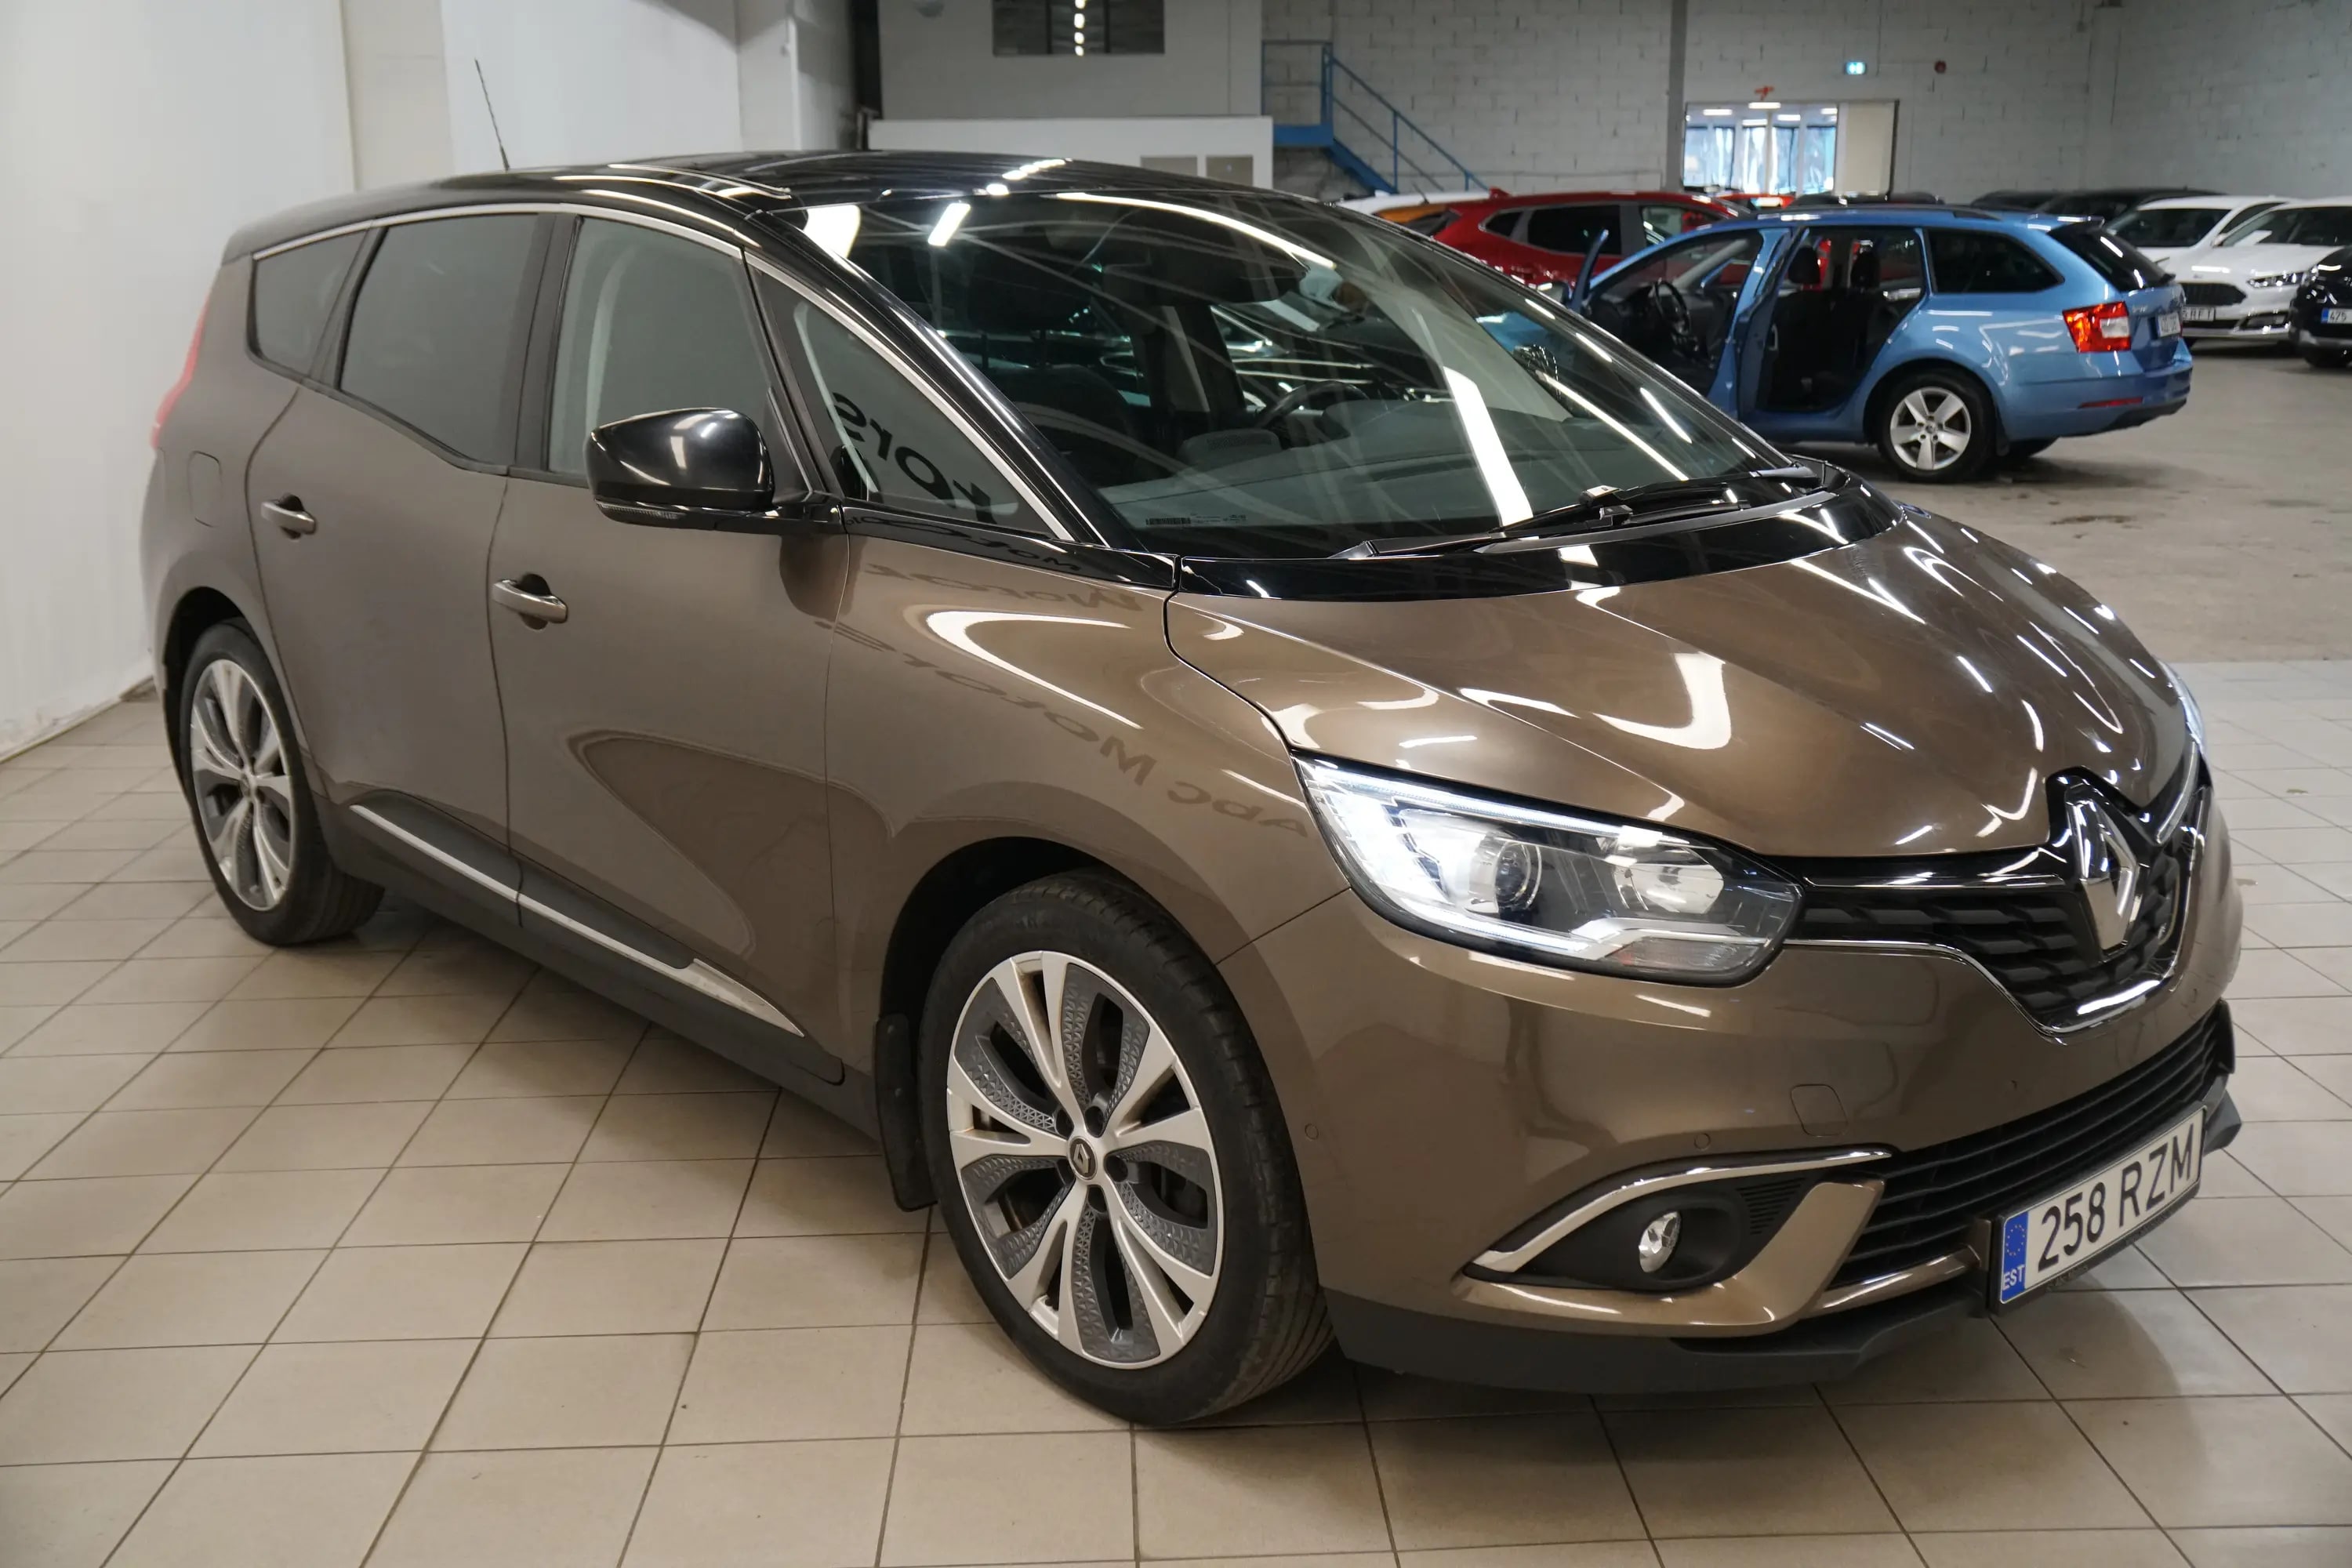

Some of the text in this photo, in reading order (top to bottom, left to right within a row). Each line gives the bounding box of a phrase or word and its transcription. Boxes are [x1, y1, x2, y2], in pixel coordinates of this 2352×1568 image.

[2038, 1123, 2194, 1273] 258 RZM
[2003, 1265, 2025, 1290] EST
